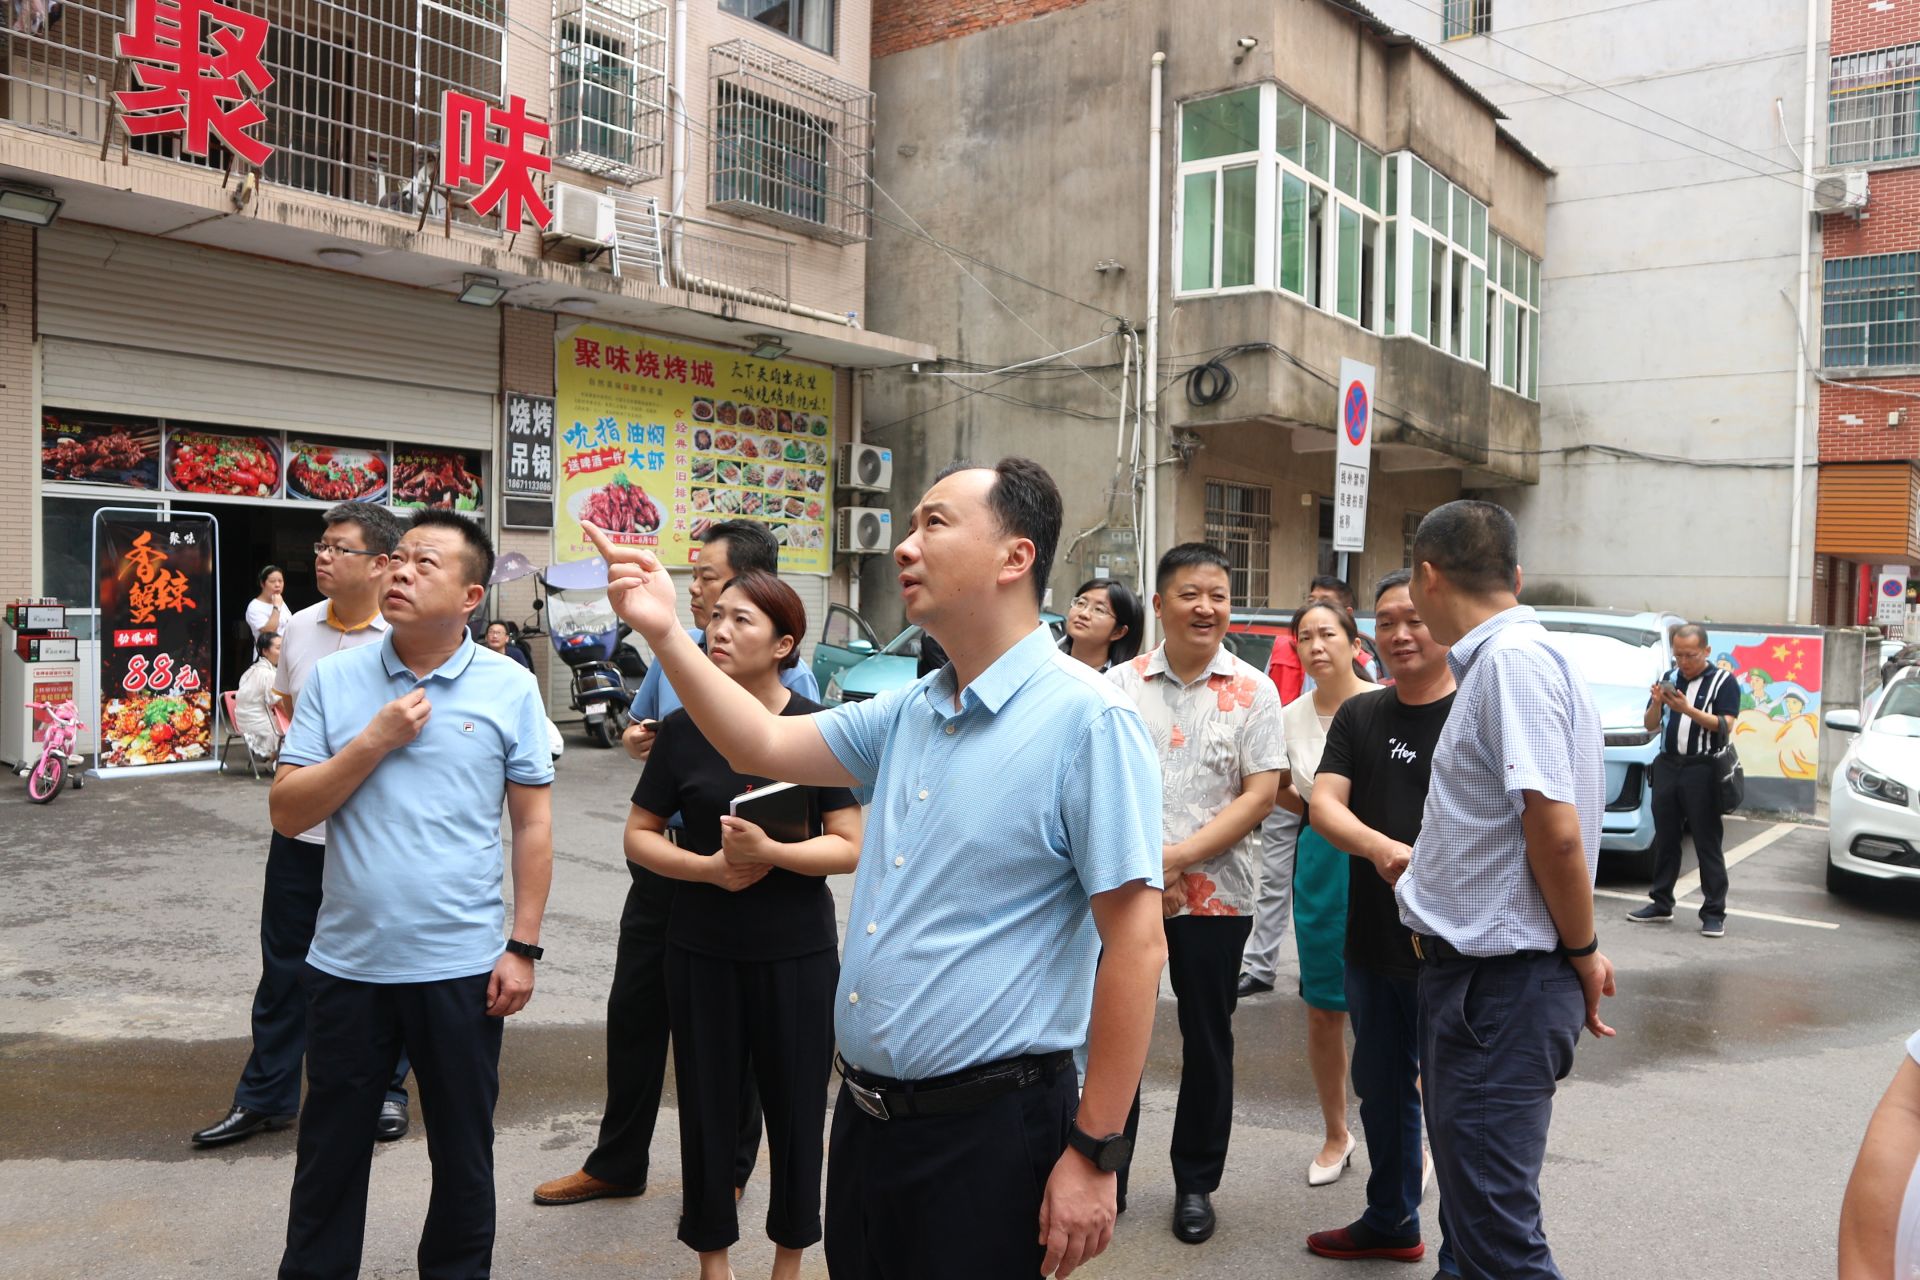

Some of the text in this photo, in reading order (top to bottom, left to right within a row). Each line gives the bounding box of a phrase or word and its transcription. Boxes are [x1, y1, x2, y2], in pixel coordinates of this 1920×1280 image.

[574, 337, 716, 388] 聚味烧烤城
[509, 398, 553, 438] 烧烤
[510, 442, 551, 479] 吊锅
[627, 450, 666, 472] 大虾
